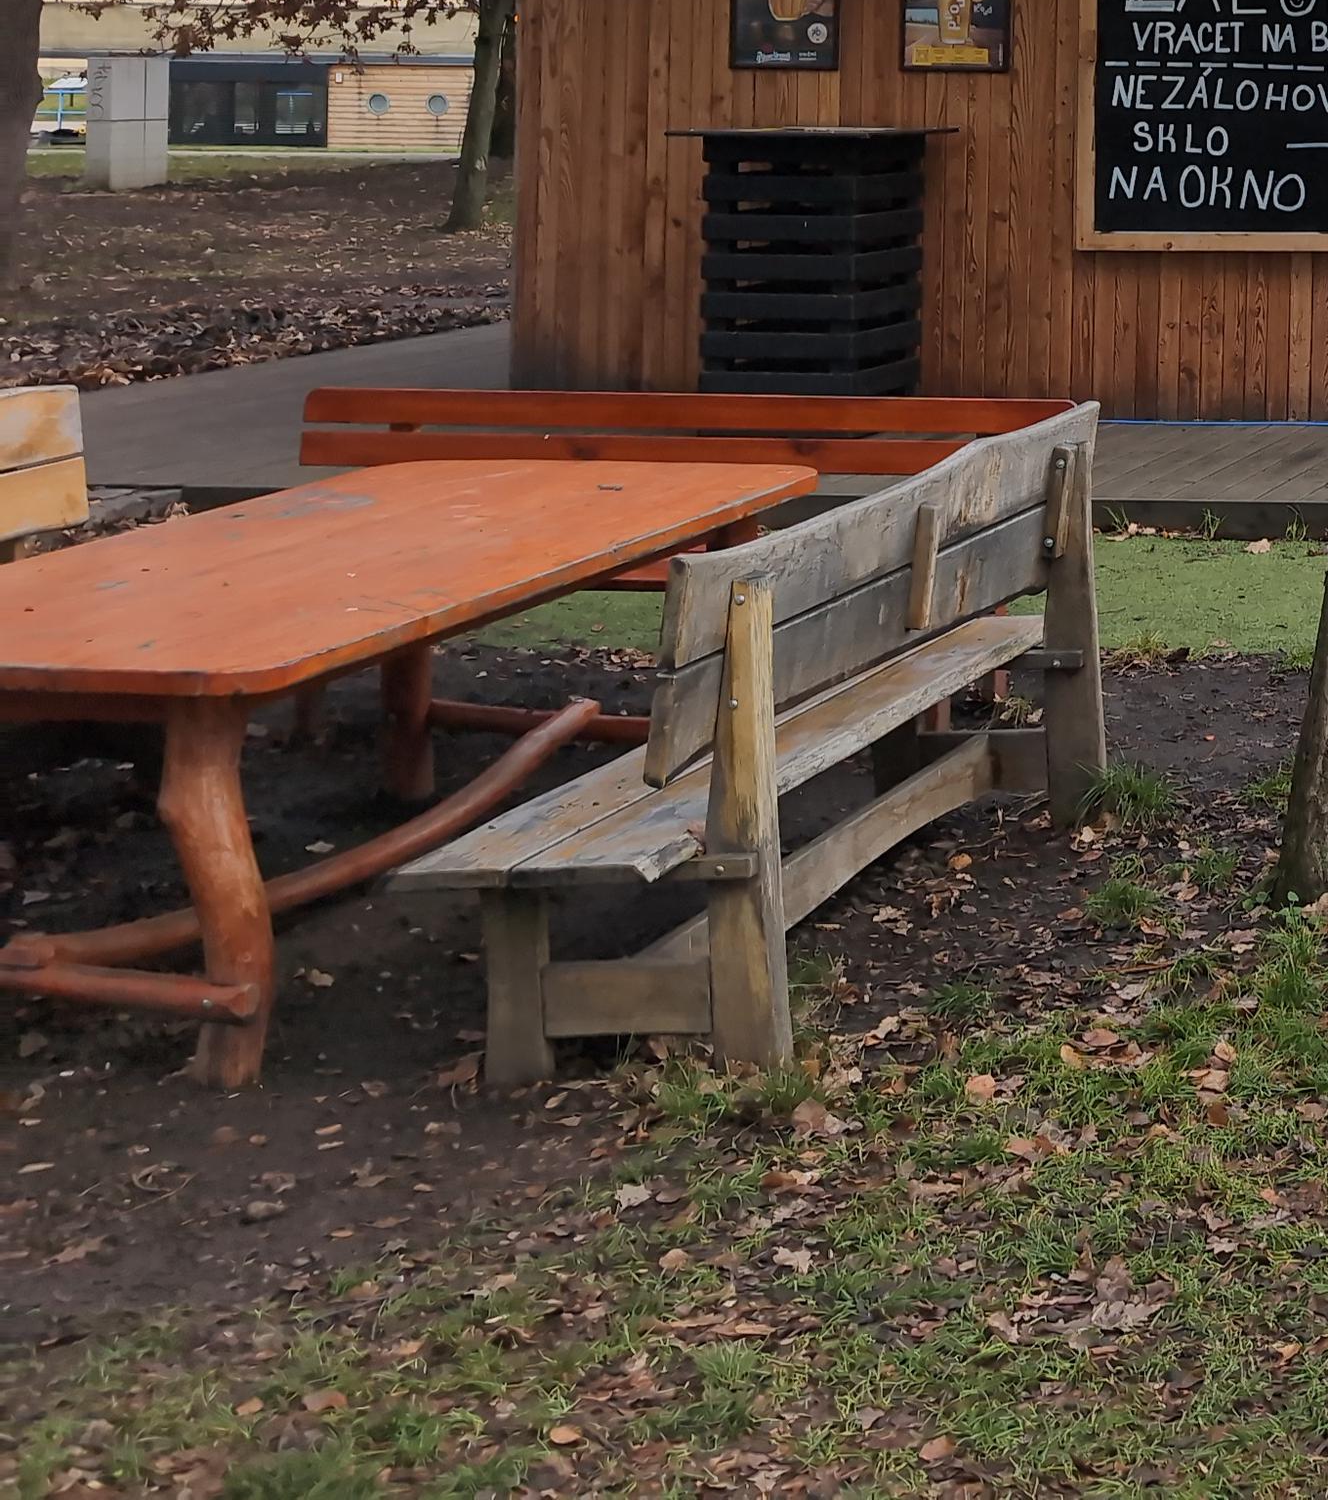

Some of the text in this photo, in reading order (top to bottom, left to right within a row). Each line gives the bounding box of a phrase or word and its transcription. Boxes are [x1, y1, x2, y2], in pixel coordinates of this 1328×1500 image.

[1132, 21, 1244, 54] VRACET
[1262, 23, 1296, 53] NA
[1133, 121, 1229, 156] SKLO
[1108, 164, 1306, 212] NA OKNO
